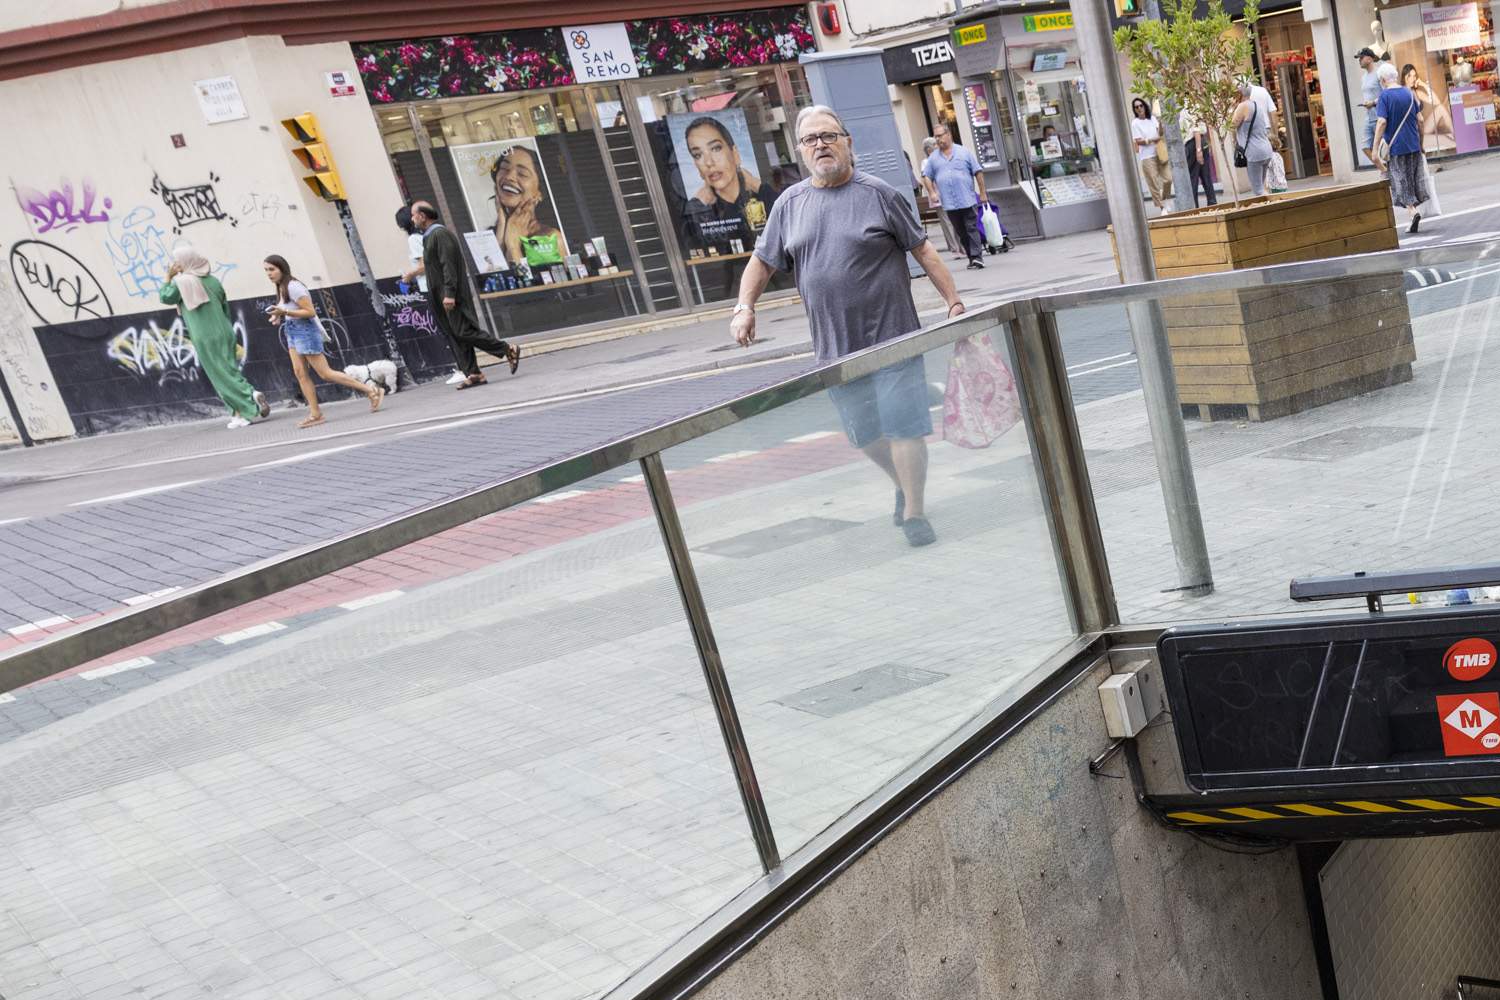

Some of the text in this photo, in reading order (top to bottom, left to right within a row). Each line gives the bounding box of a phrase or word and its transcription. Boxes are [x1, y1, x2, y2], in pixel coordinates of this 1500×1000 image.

[1040, 15, 1073, 28] ONCE
[963, 28, 984, 42] ONCE
[582, 50, 614, 64] SAN
[586, 63, 631, 78] REMO
[1453, 653, 1490, 668] TMB
[1459, 709, 1482, 729] M
